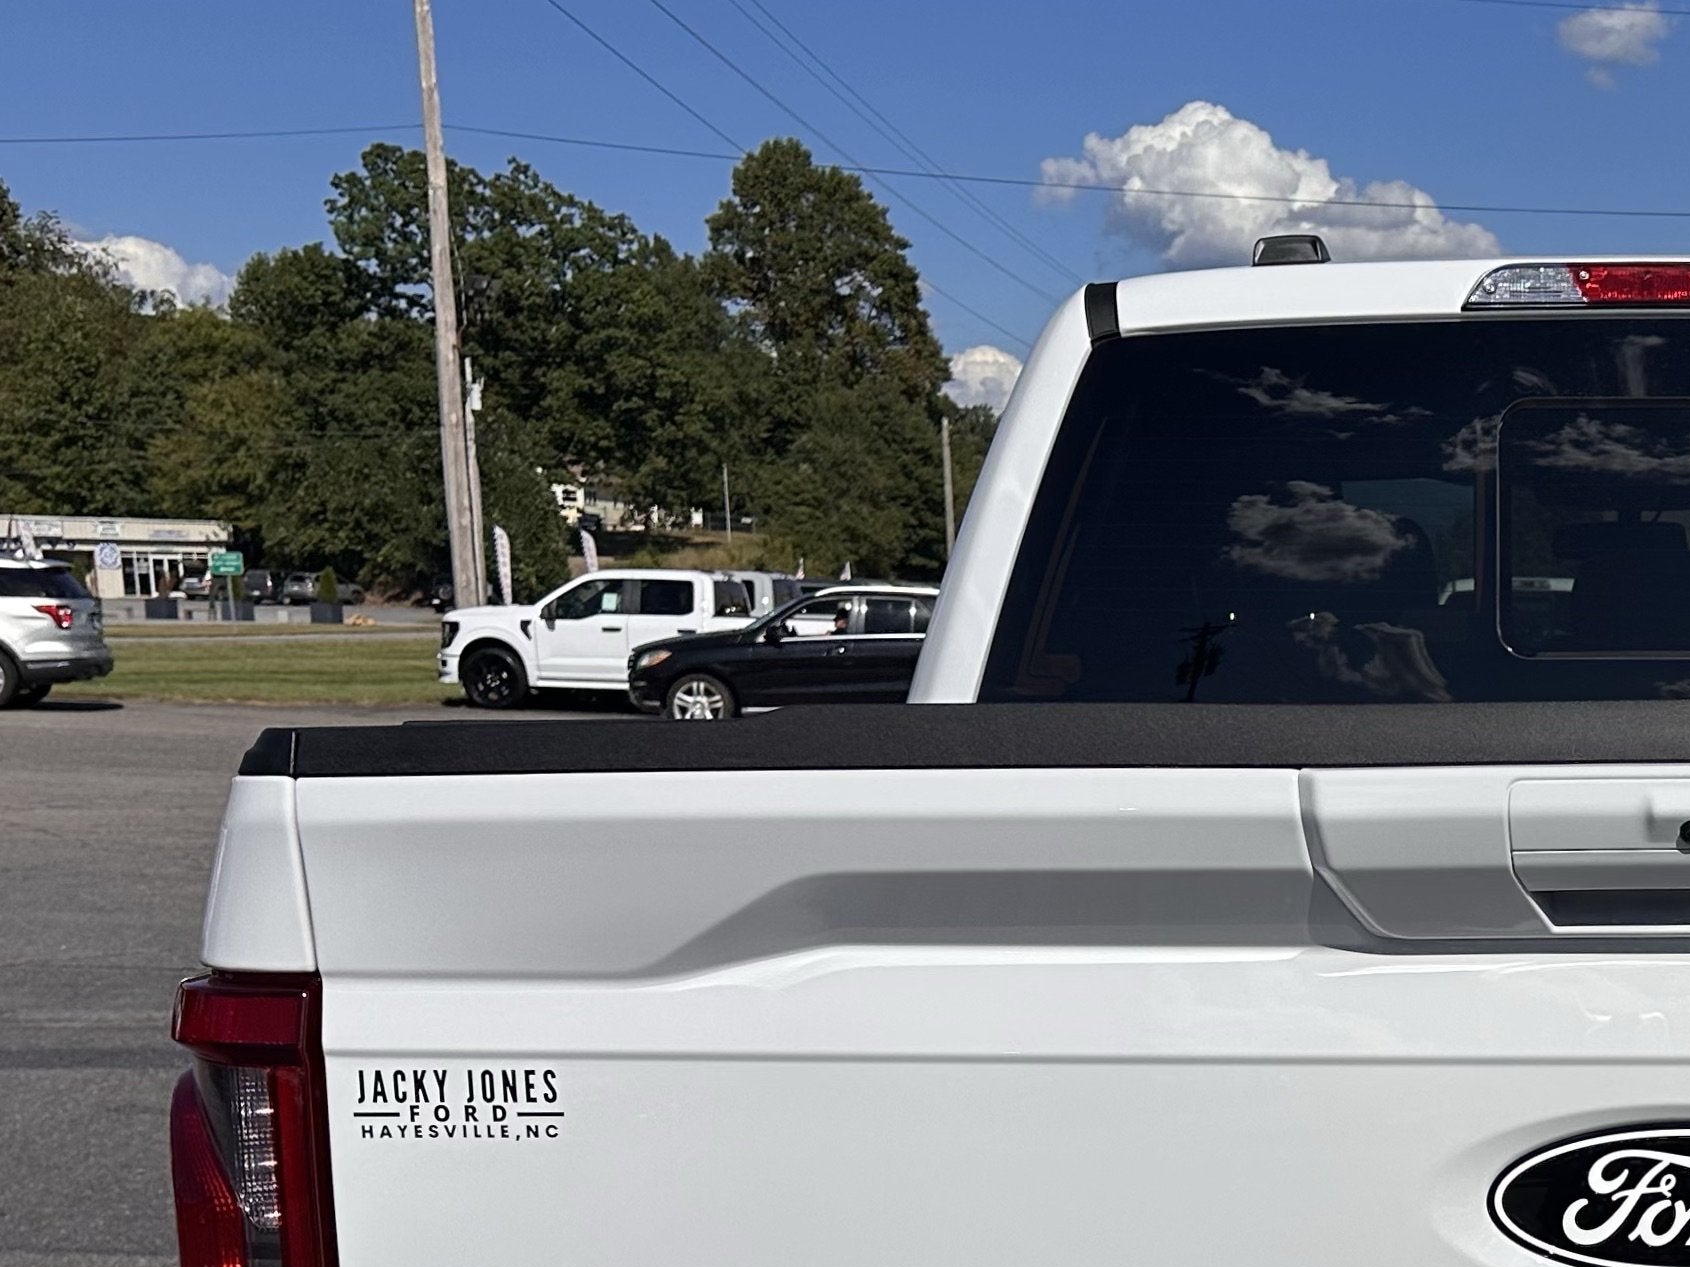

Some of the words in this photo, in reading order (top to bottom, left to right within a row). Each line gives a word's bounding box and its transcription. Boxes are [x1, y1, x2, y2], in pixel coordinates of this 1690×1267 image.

[357, 1069, 448, 1104] JACKY
[466, 1069, 559, 1104] JONES
[409, 1105, 508, 1123] FORD
